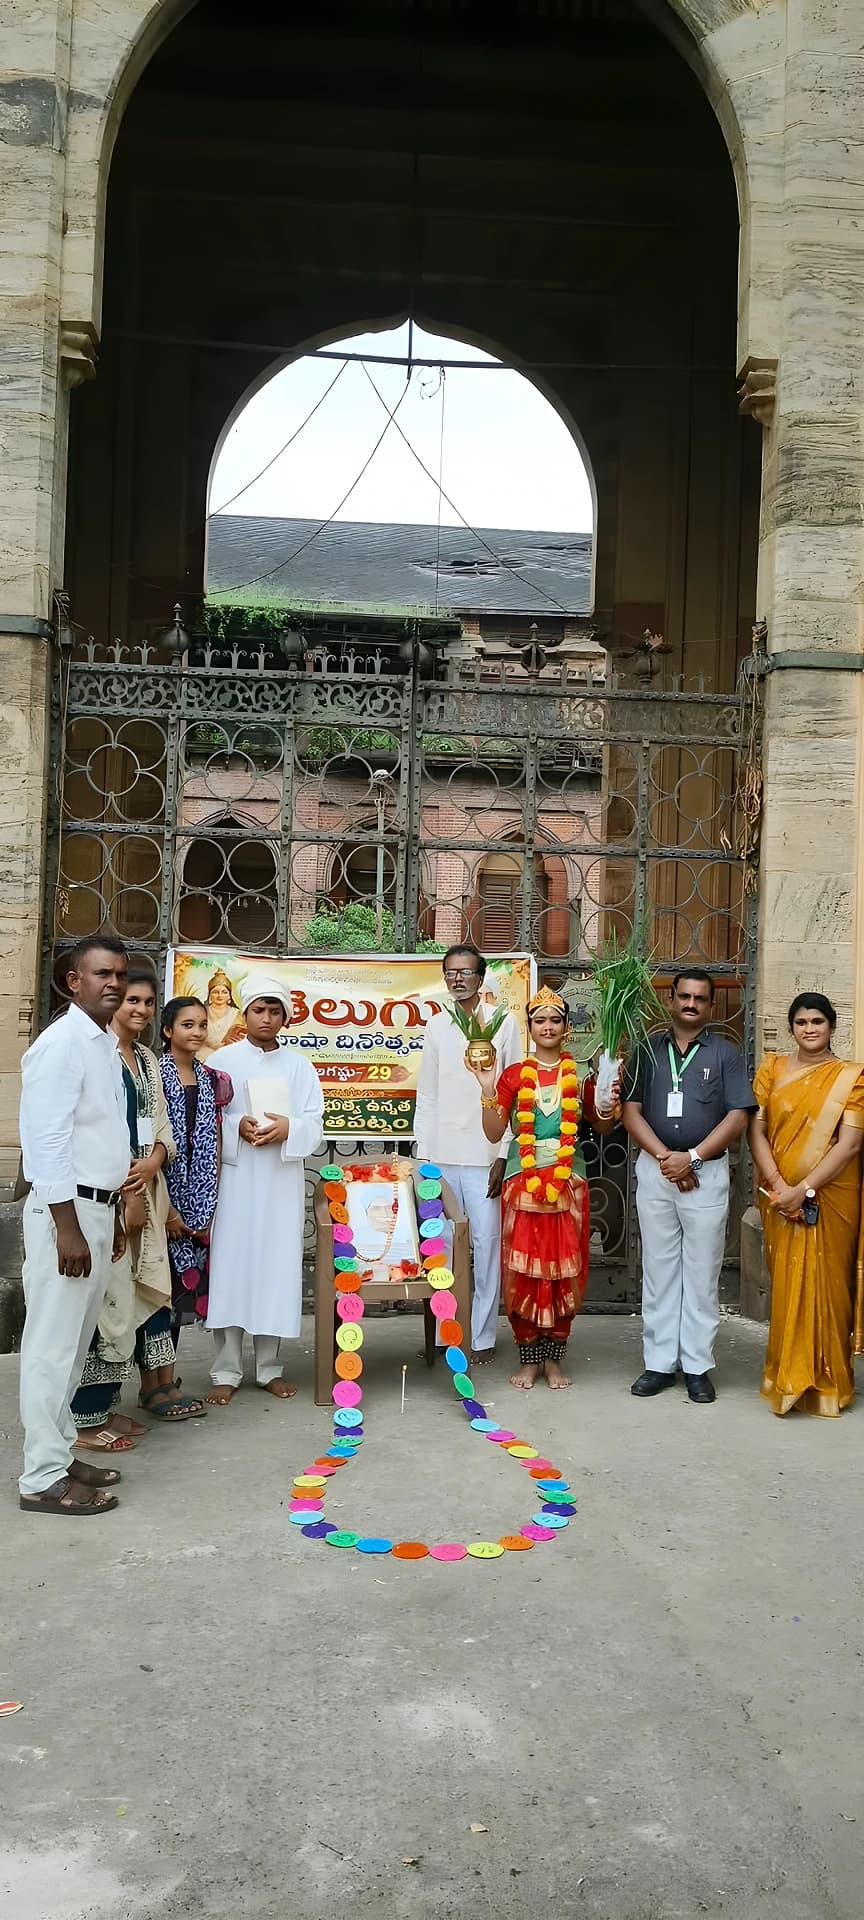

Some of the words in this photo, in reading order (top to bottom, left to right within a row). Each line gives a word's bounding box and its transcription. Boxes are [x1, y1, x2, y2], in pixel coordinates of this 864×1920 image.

[287, 990, 442, 1028] తెలుగు
[335, 1032, 424, 1055] దినోత్సవ
[367, 1065, 392, 1080] 29
[322, 1099, 362, 1115] భుత్వ
[366, 1099, 411, 1116] ఉన్నత
[325, 1114, 409, 1133] తపట్నం
